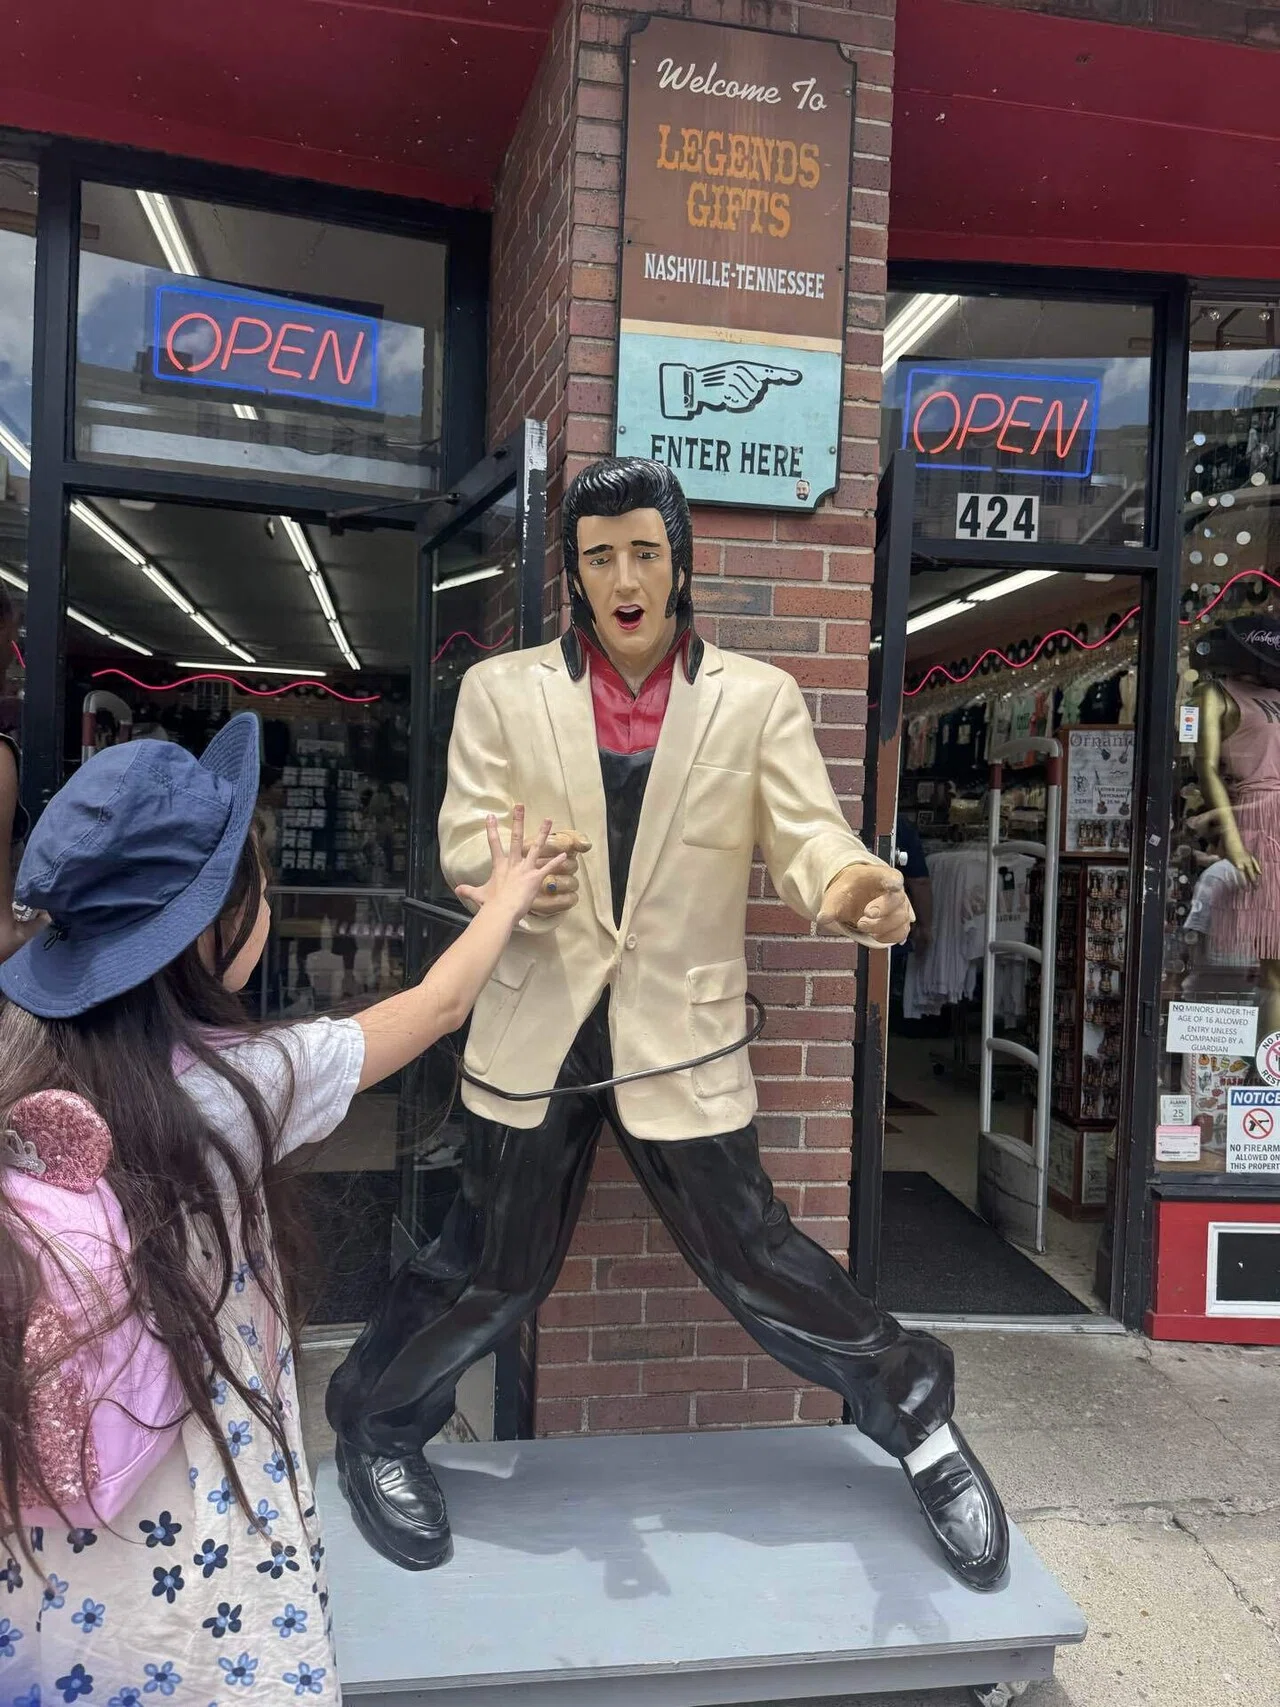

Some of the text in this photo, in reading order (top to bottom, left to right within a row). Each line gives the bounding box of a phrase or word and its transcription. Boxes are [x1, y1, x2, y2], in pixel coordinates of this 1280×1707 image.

[657, 57, 828, 111] Welcome To
[656, 123, 821, 190] LEGENDS
[686, 180, 791, 239] GIFTS
[166, 312, 365, 385] OPEN
[913, 391, 1089, 459] OPEN
[650, 434, 804, 479] ENTER HERE
[958, 494, 1036, 541] 424
[1172, 1004, 1256, 1017] NO MINORS UNDER THE
[1177, 1015, 1249, 1026] AGE OF 16 ALLOWED
[1187, 1025, 1238, 1035] ENTRY UNLESS
[1179, 1034, 1228, 1043] ACOMPANIED
[1228, 1036, 1238, 1044] BY
[1262, 1037, 1274, 1050] NO
[1191, 1044, 1229, 1053] GUARDIAN
[1262, 1069, 1280, 1086] REST
[1233, 1091, 1280, 1104] NOTICE
[1172, 1108, 1184, 1118] 25
[1229, 1143, 1280, 1152] NO FIREARM
[1235, 1153, 1268, 1161] ALLOWED
[1230, 1162, 1280, 1170] THIS PROPERT
